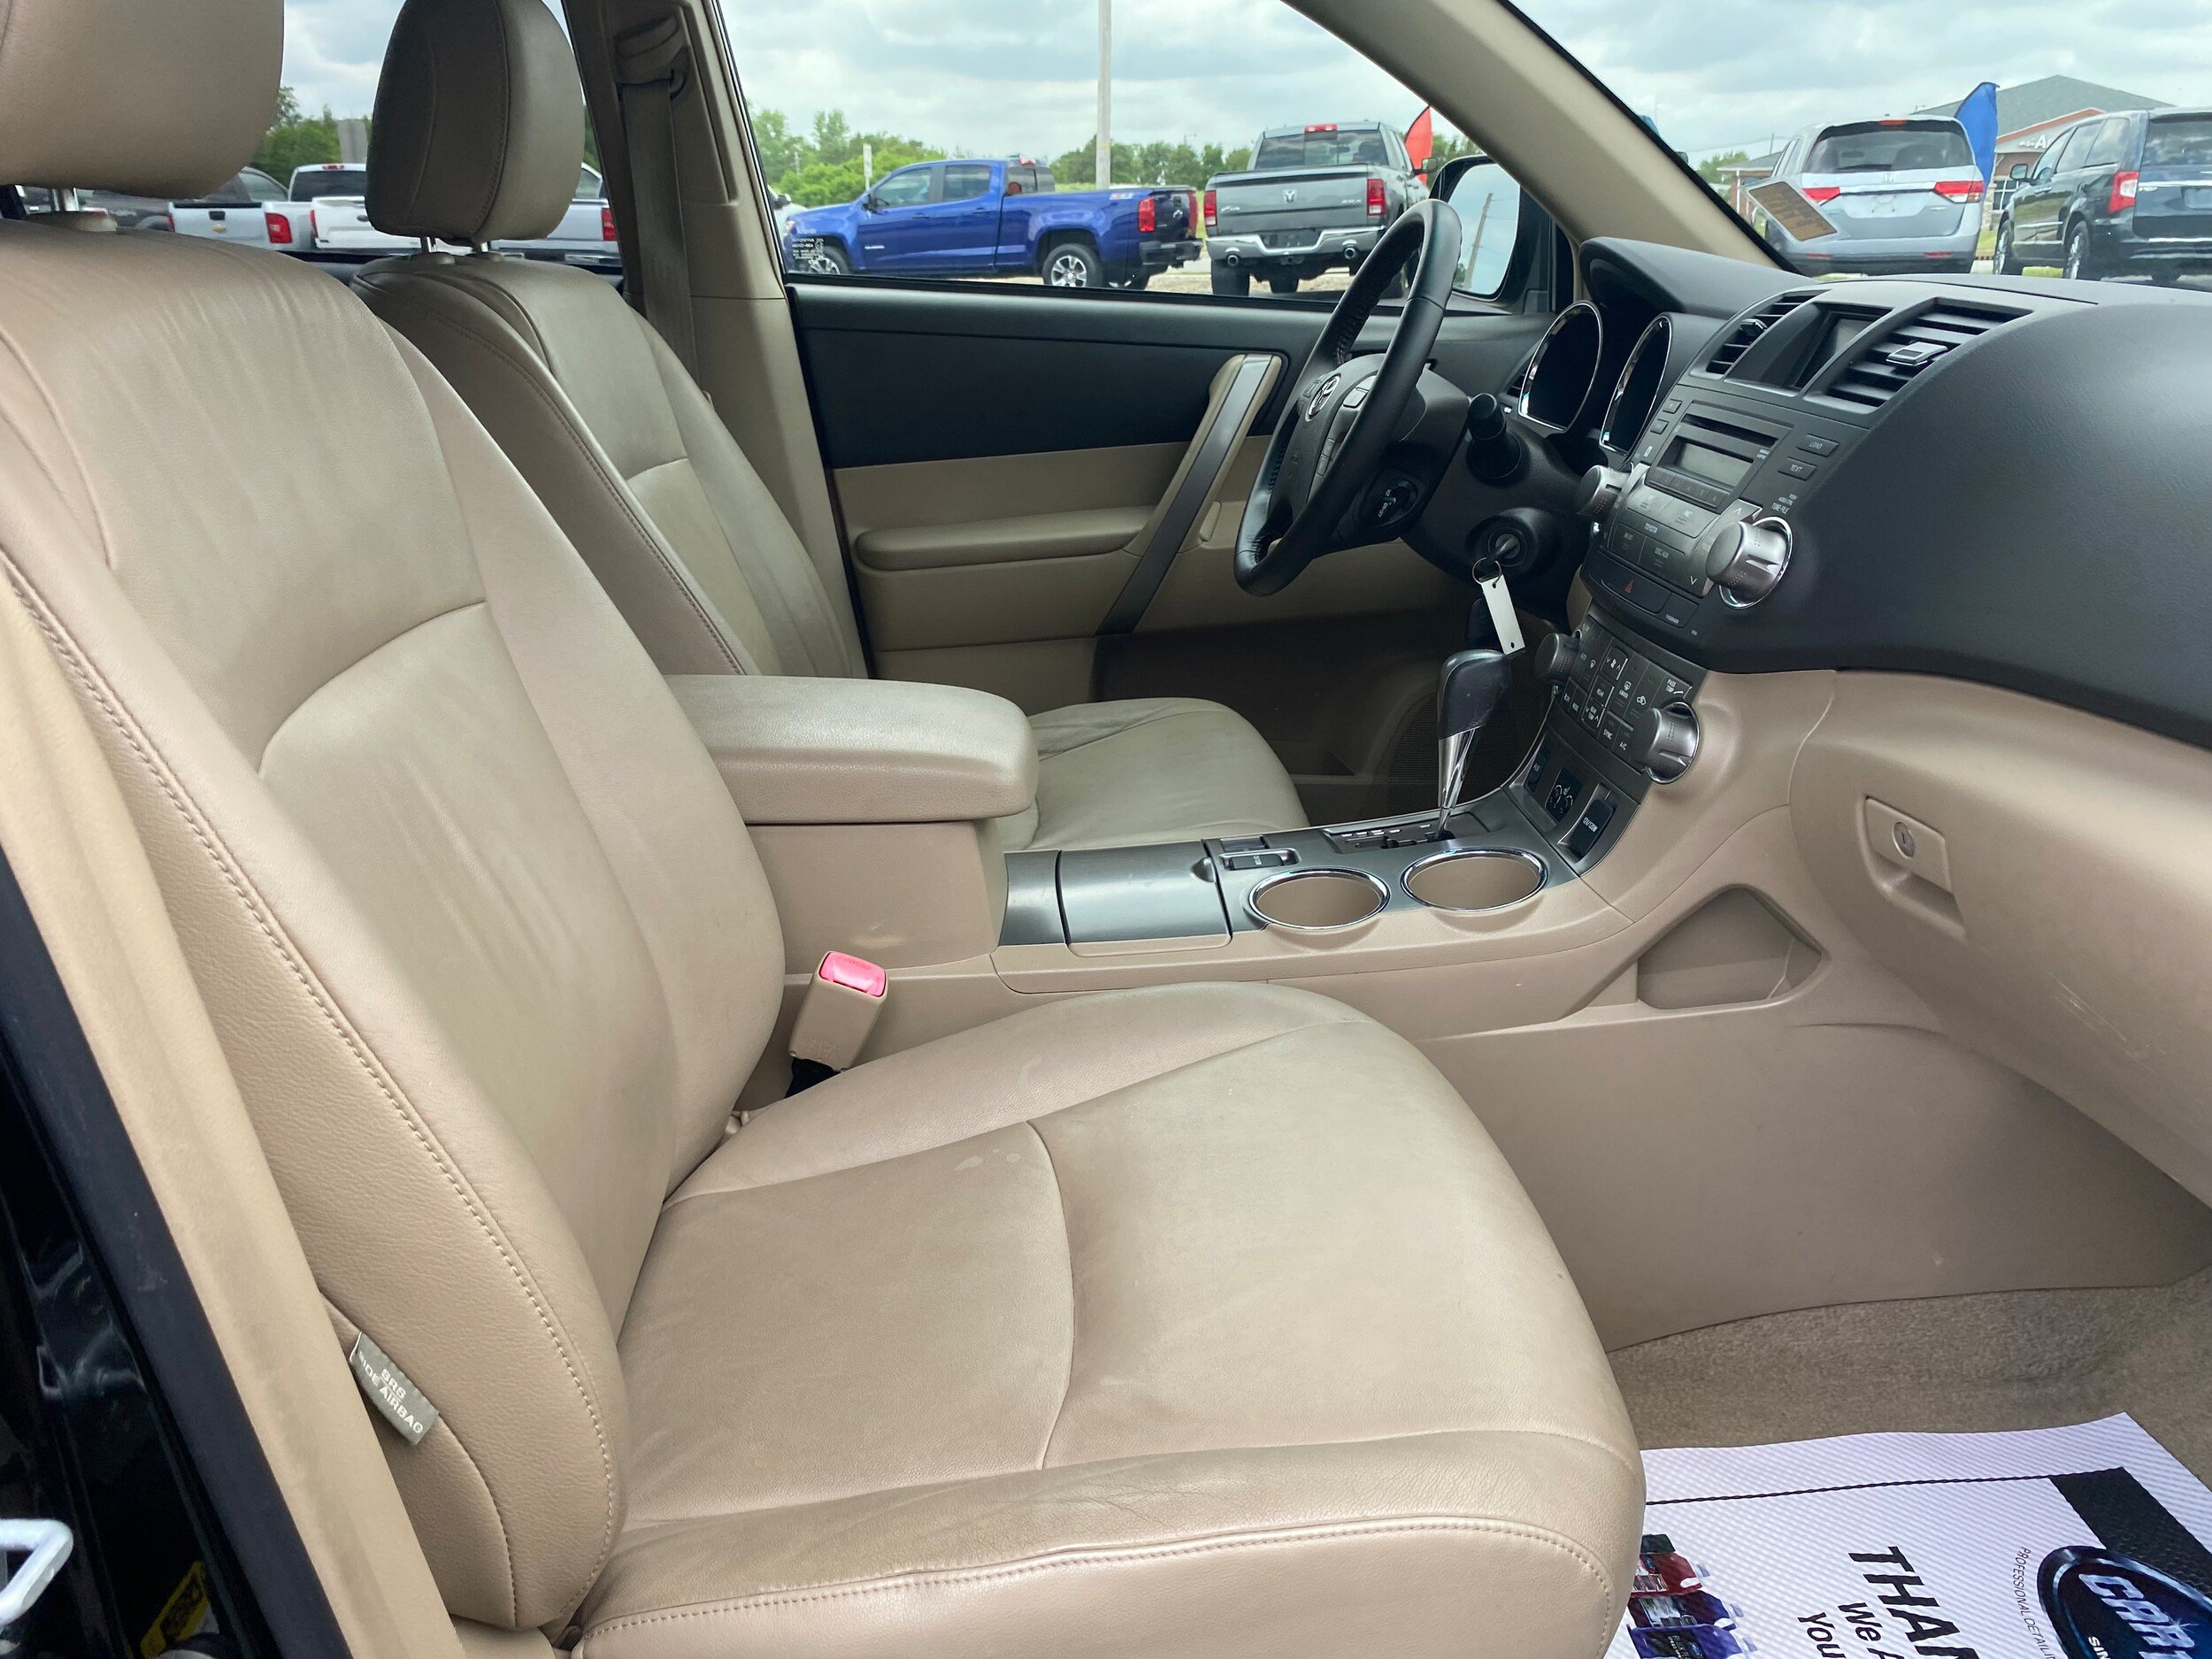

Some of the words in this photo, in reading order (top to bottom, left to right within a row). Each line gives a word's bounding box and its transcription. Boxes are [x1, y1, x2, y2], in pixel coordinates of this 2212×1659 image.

[381, 1369, 406, 1400] SRS
[380, 1387, 424, 1434] AIRBAG
[2012, 1547, 2032, 1619] PROFESSIONAL
[1838, 1602, 1882, 1642] We
